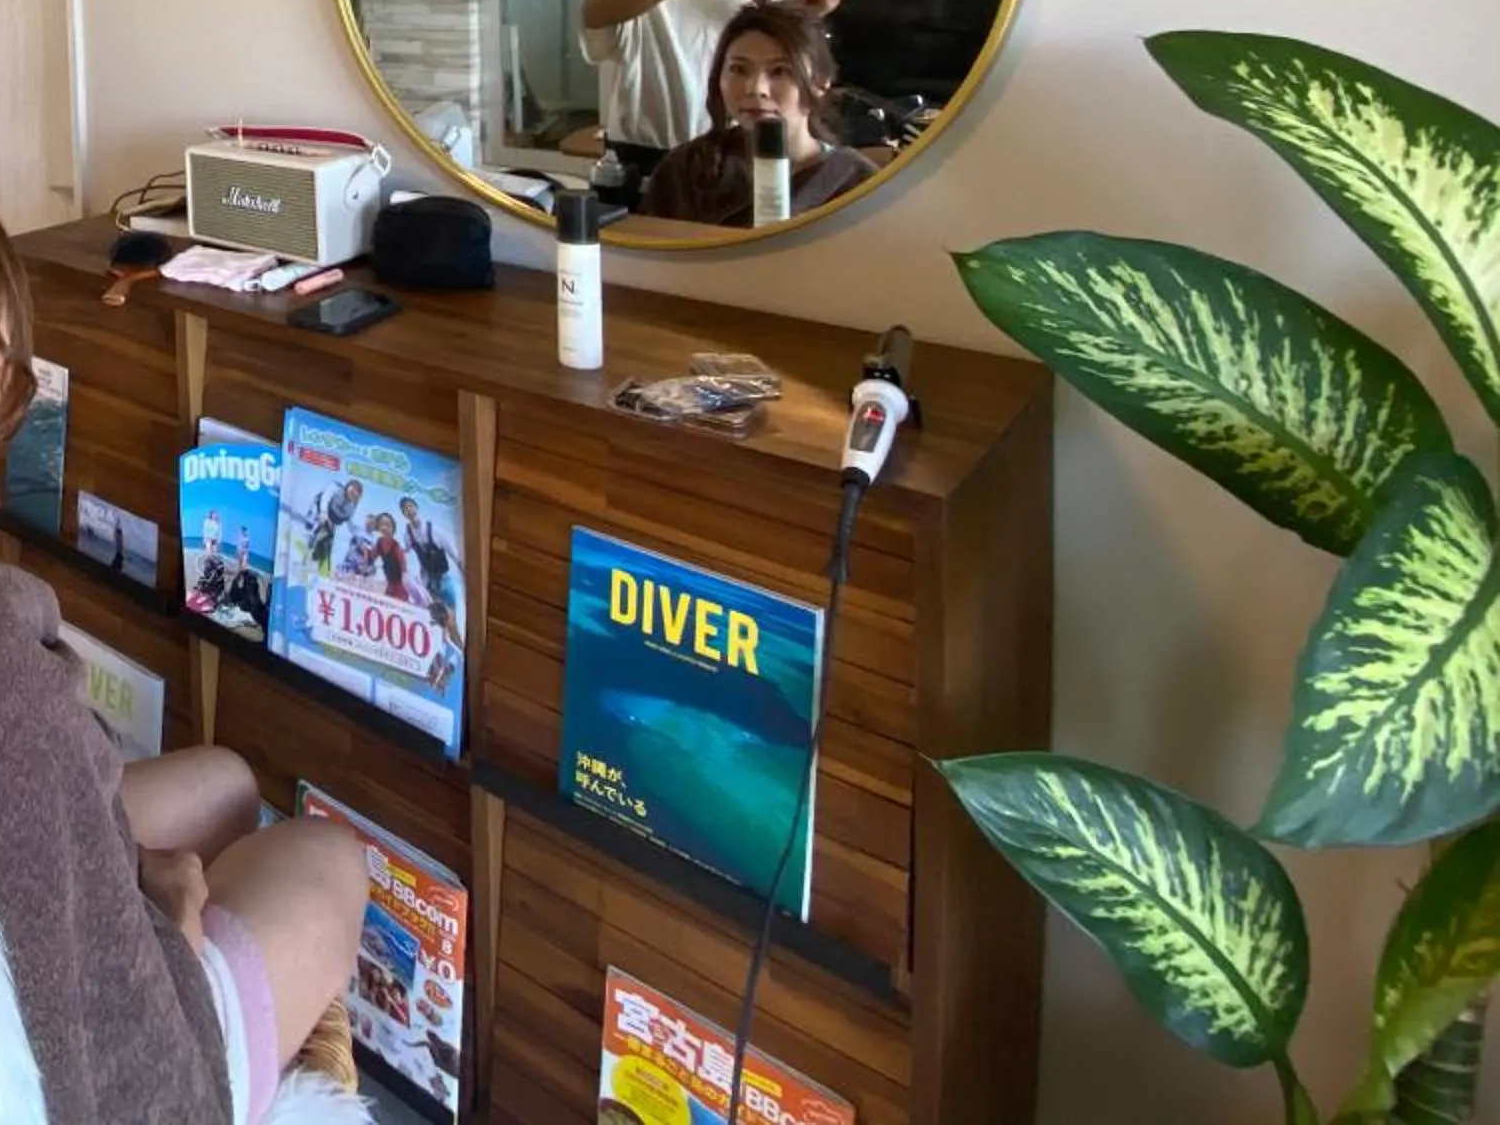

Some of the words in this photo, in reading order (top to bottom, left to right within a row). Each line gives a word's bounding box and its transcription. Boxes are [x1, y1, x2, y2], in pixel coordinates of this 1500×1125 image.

[184, 448, 281, 491] DivingG
[318, 588, 431, 658] ¥1,000
[610, 568, 760, 674] DIVER
